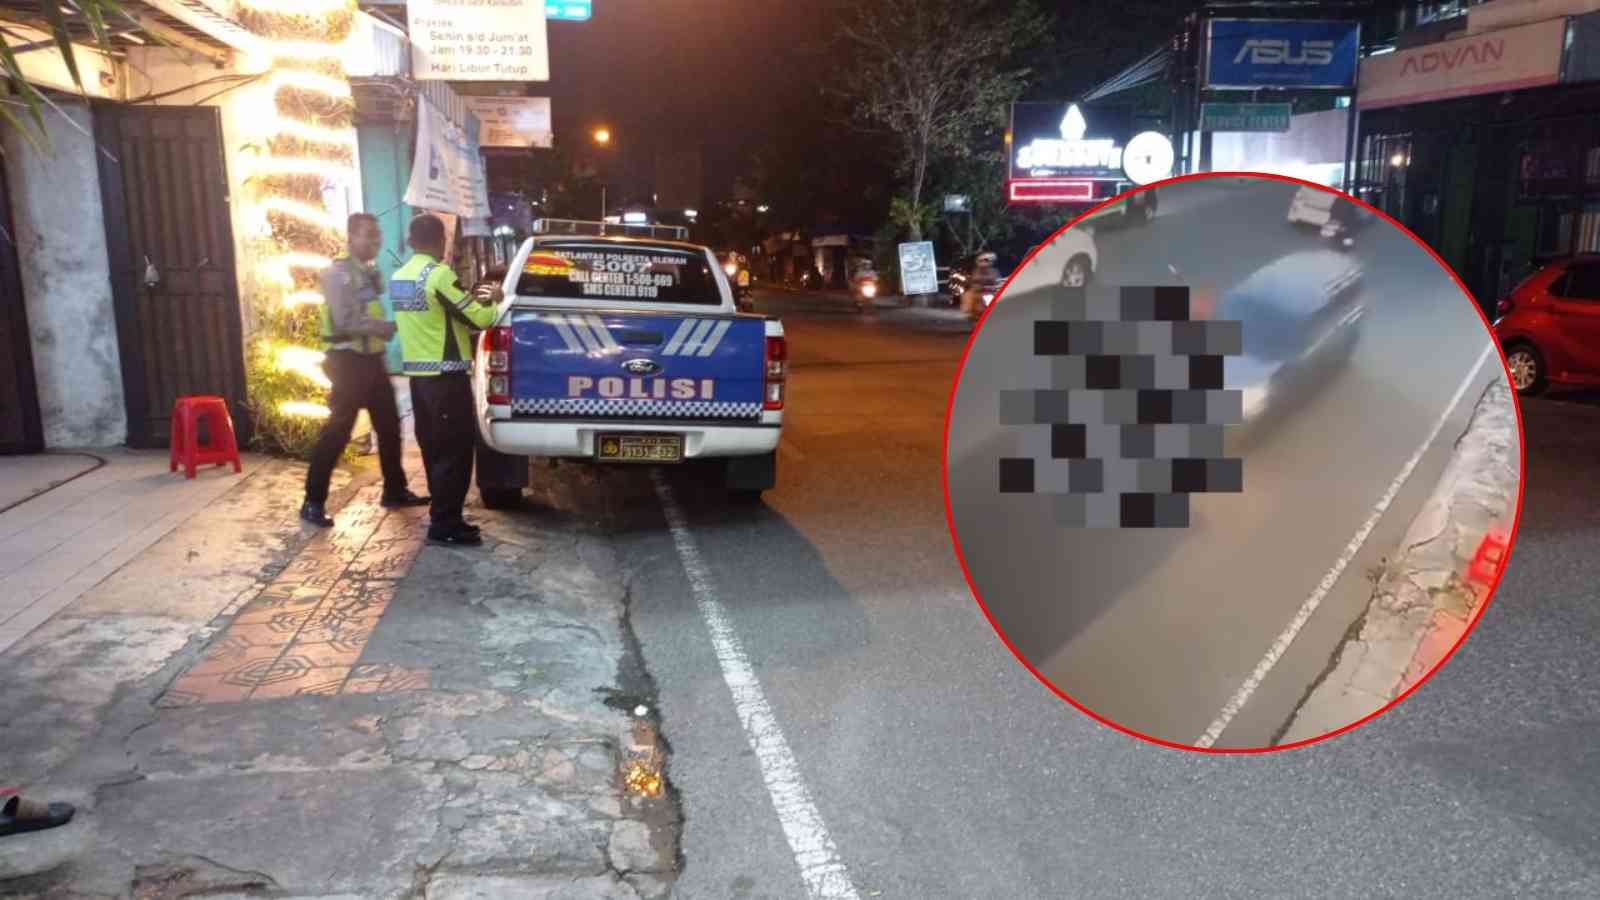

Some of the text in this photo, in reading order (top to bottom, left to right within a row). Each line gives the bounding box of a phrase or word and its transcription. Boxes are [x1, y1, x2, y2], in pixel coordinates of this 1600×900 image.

[430, 45, 456, 56] Jam
[1232, 39, 1335, 65] ASUS
[1400, 39, 1505, 78] ADVAN
[430, 63, 528, 75] Hari Libur Tutup
[568, 269, 590, 283] CALL
[591, 271, 625, 284] CENTER
[583, 283, 603, 295] SMS
[604, 284, 636, 297] CENTER
[568, 376, 715, 399] POLISI
